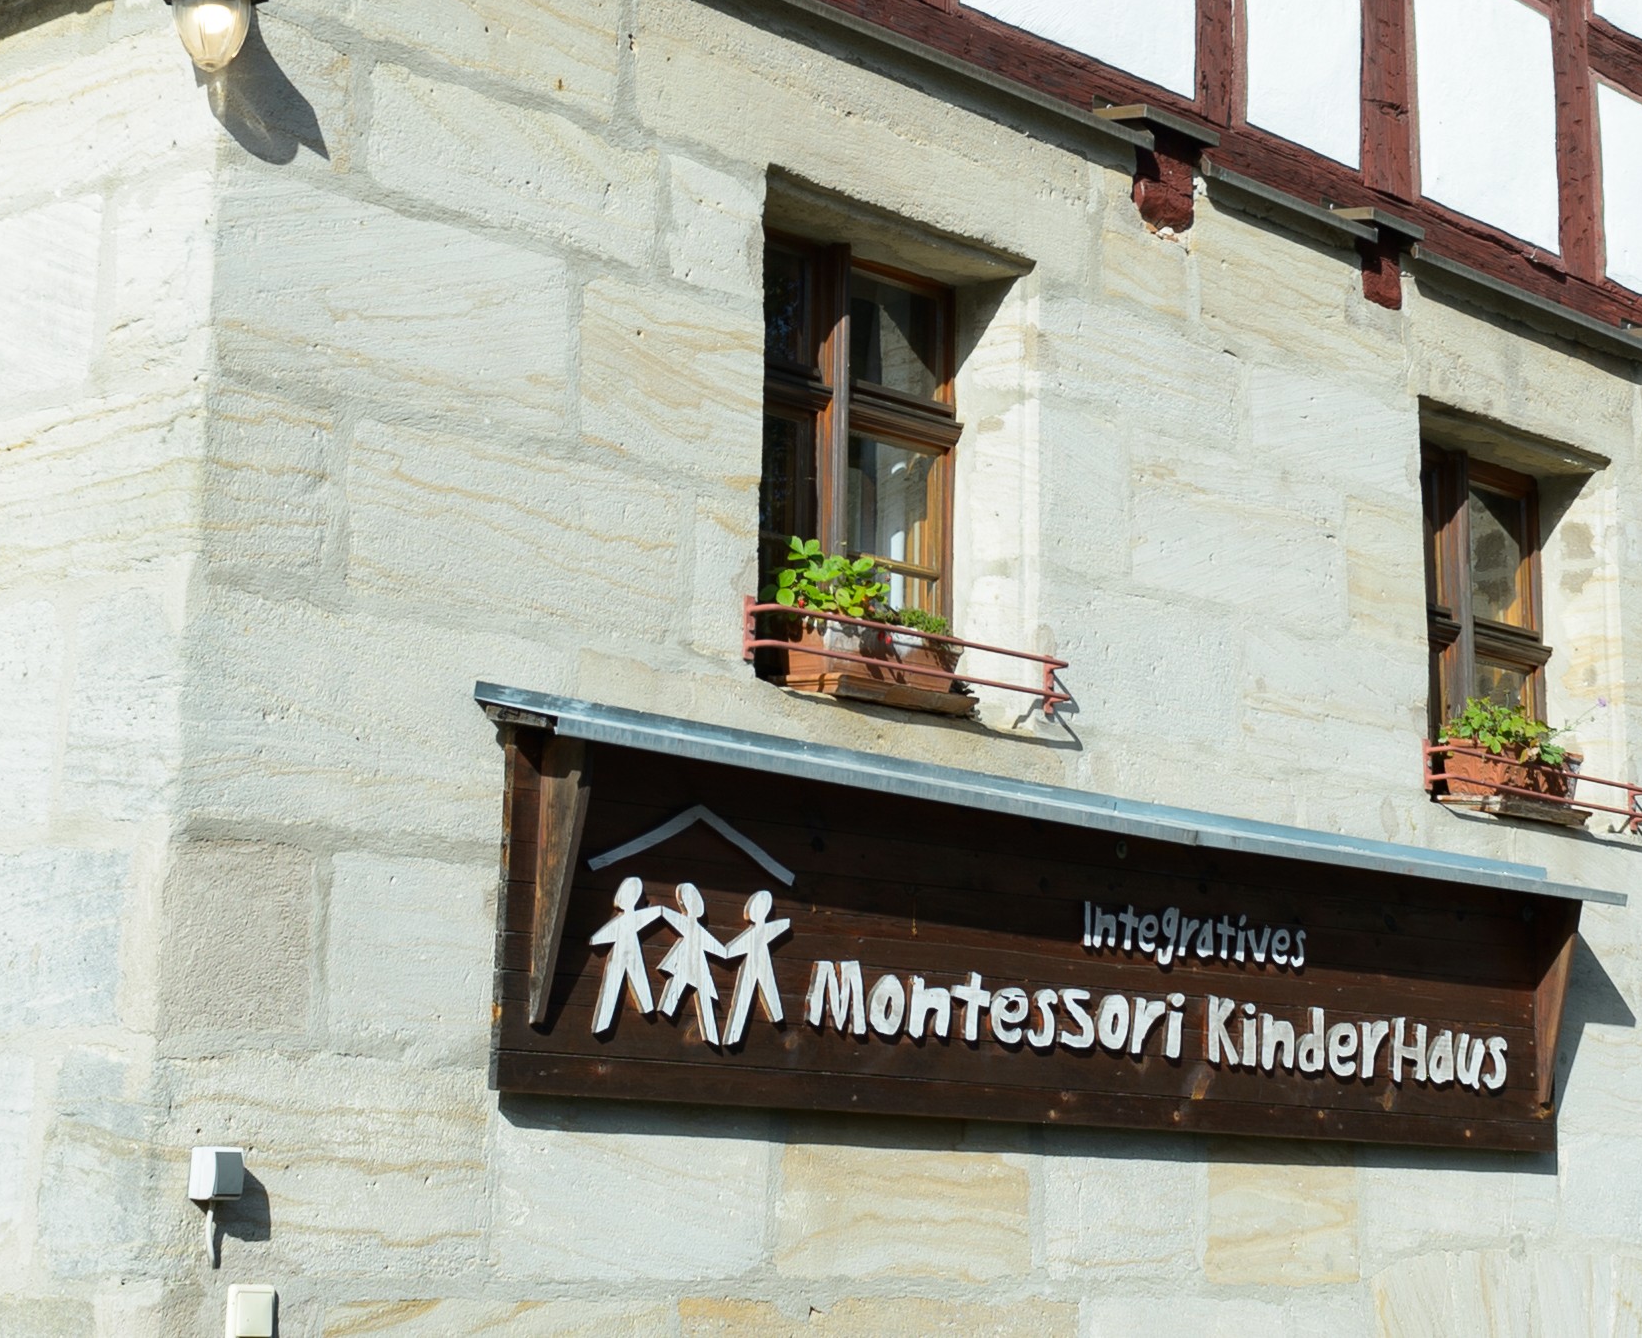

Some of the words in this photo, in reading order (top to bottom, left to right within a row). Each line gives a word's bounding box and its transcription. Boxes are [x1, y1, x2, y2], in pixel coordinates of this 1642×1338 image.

[1083, 900, 1307, 969] Integratives
[804, 960, 1186, 1060] Montessori
[1204, 993, 1508, 1091] KinderHaus
